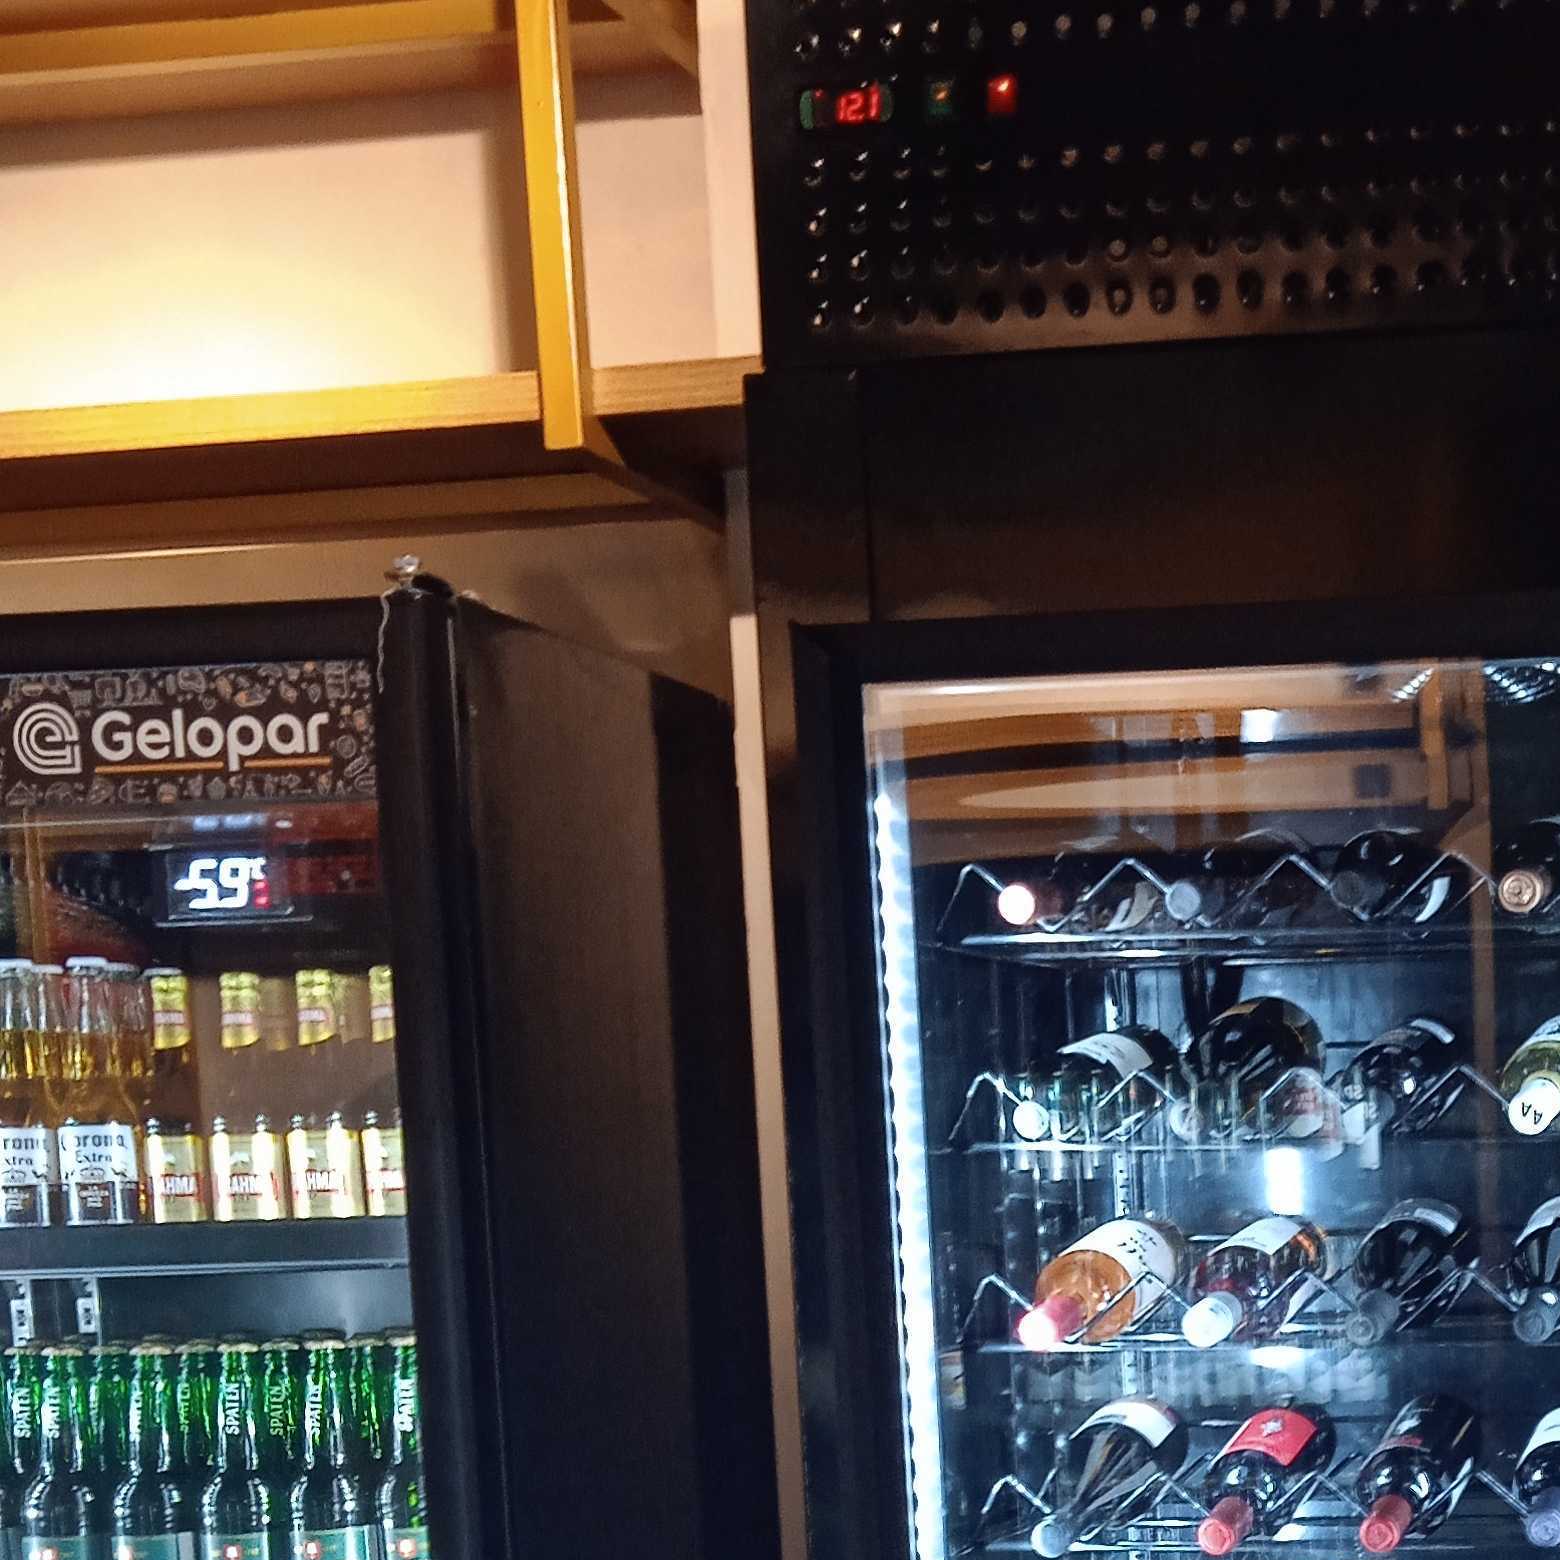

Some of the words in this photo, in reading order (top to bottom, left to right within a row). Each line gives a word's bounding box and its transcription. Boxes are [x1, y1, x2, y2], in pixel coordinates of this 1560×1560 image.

[91, 708, 330, 772] Gelopar
[225, 1383, 240, 1435] SPATEN
[269, 1385, 285, 1436] SPATEN
